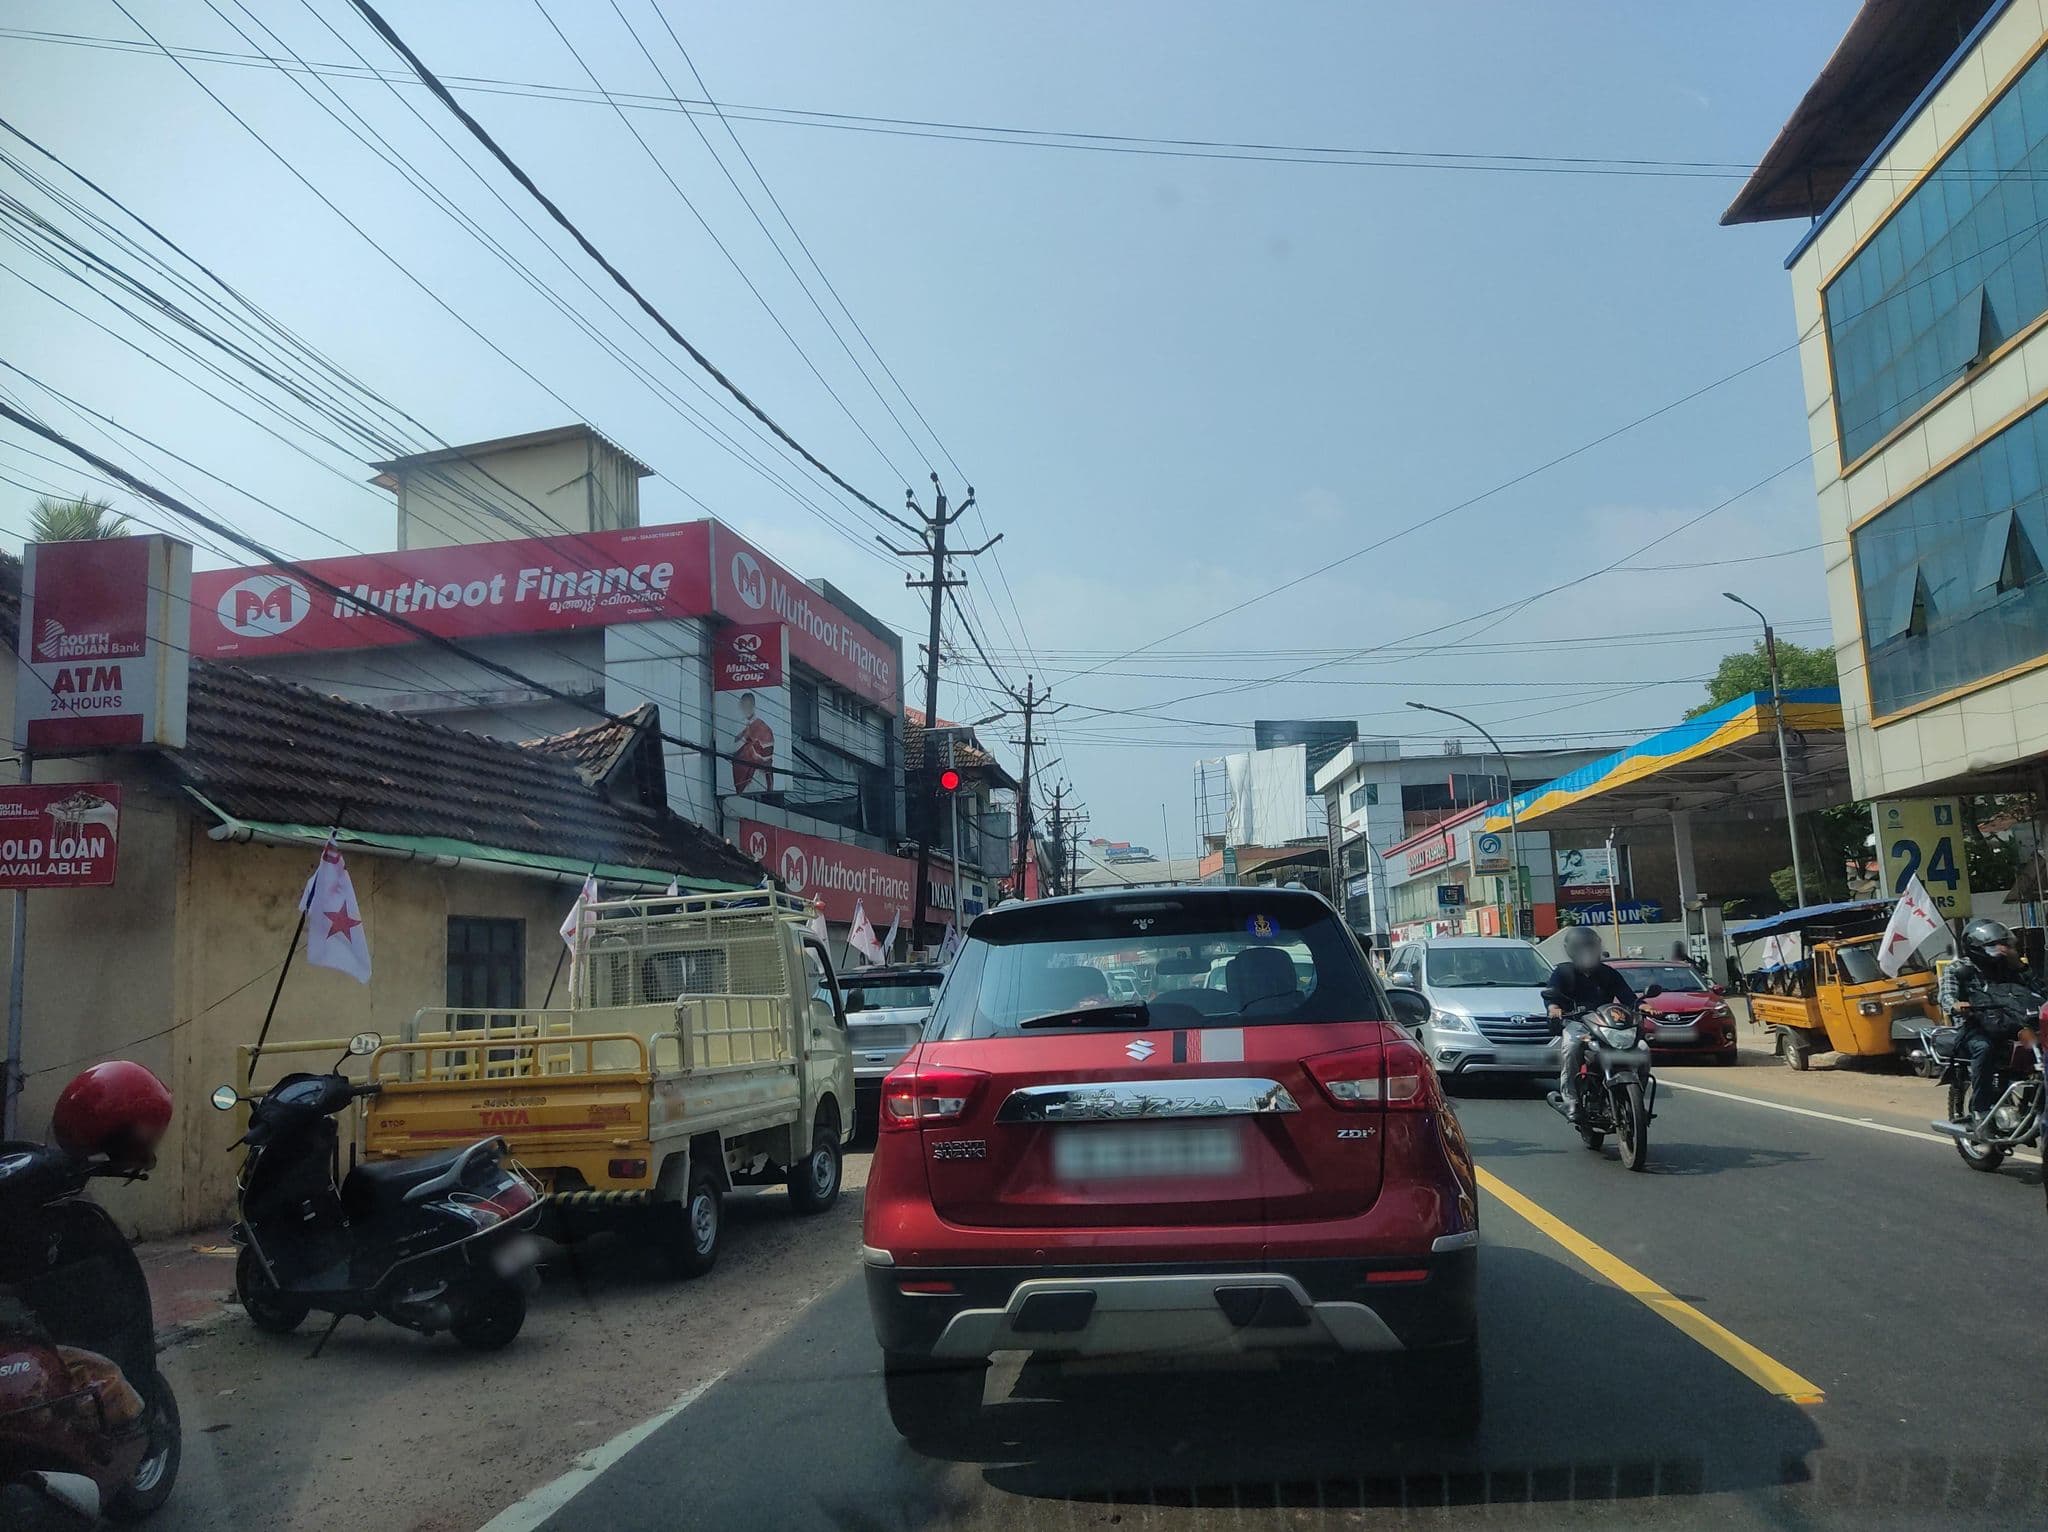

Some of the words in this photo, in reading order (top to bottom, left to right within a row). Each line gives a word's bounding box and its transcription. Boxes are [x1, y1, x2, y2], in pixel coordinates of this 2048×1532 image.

[332, 573, 505, 619] Muthoot
[514, 561, 675, 603] Finance
[59, 632, 110, 645] SOUTH
[770, 577, 838, 653] Muthoot
[840, 625, 889, 686] Finance
[59, 643, 109, 657] INDIAN
[111, 642, 140, 654] Bank
[737, 653, 758, 663] The
[53, 665, 123, 694] ATM
[732, 672, 765, 683] Group
[51, 699, 66, 712] 24
[70, 695, 122, 711] HOURS
[0, 802, 22, 811] OUTH
[0, 838, 43, 861] OLD
[48, 837, 106, 860] LOAN
[0, 861, 92, 876] AVAILABLE
[1891, 836, 1961, 894] 24
[811, 854, 867, 896] Muthoot
[869, 866, 909, 901] Finance
[1575, 908, 1641, 926] AMSUN
[1062, 1095, 1228, 1119] BREZZA
[480, 1109, 529, 1126] TATA
[931, 1139, 987, 1150] MARUTI
[932, 1148, 987, 1160] SUZUKI
